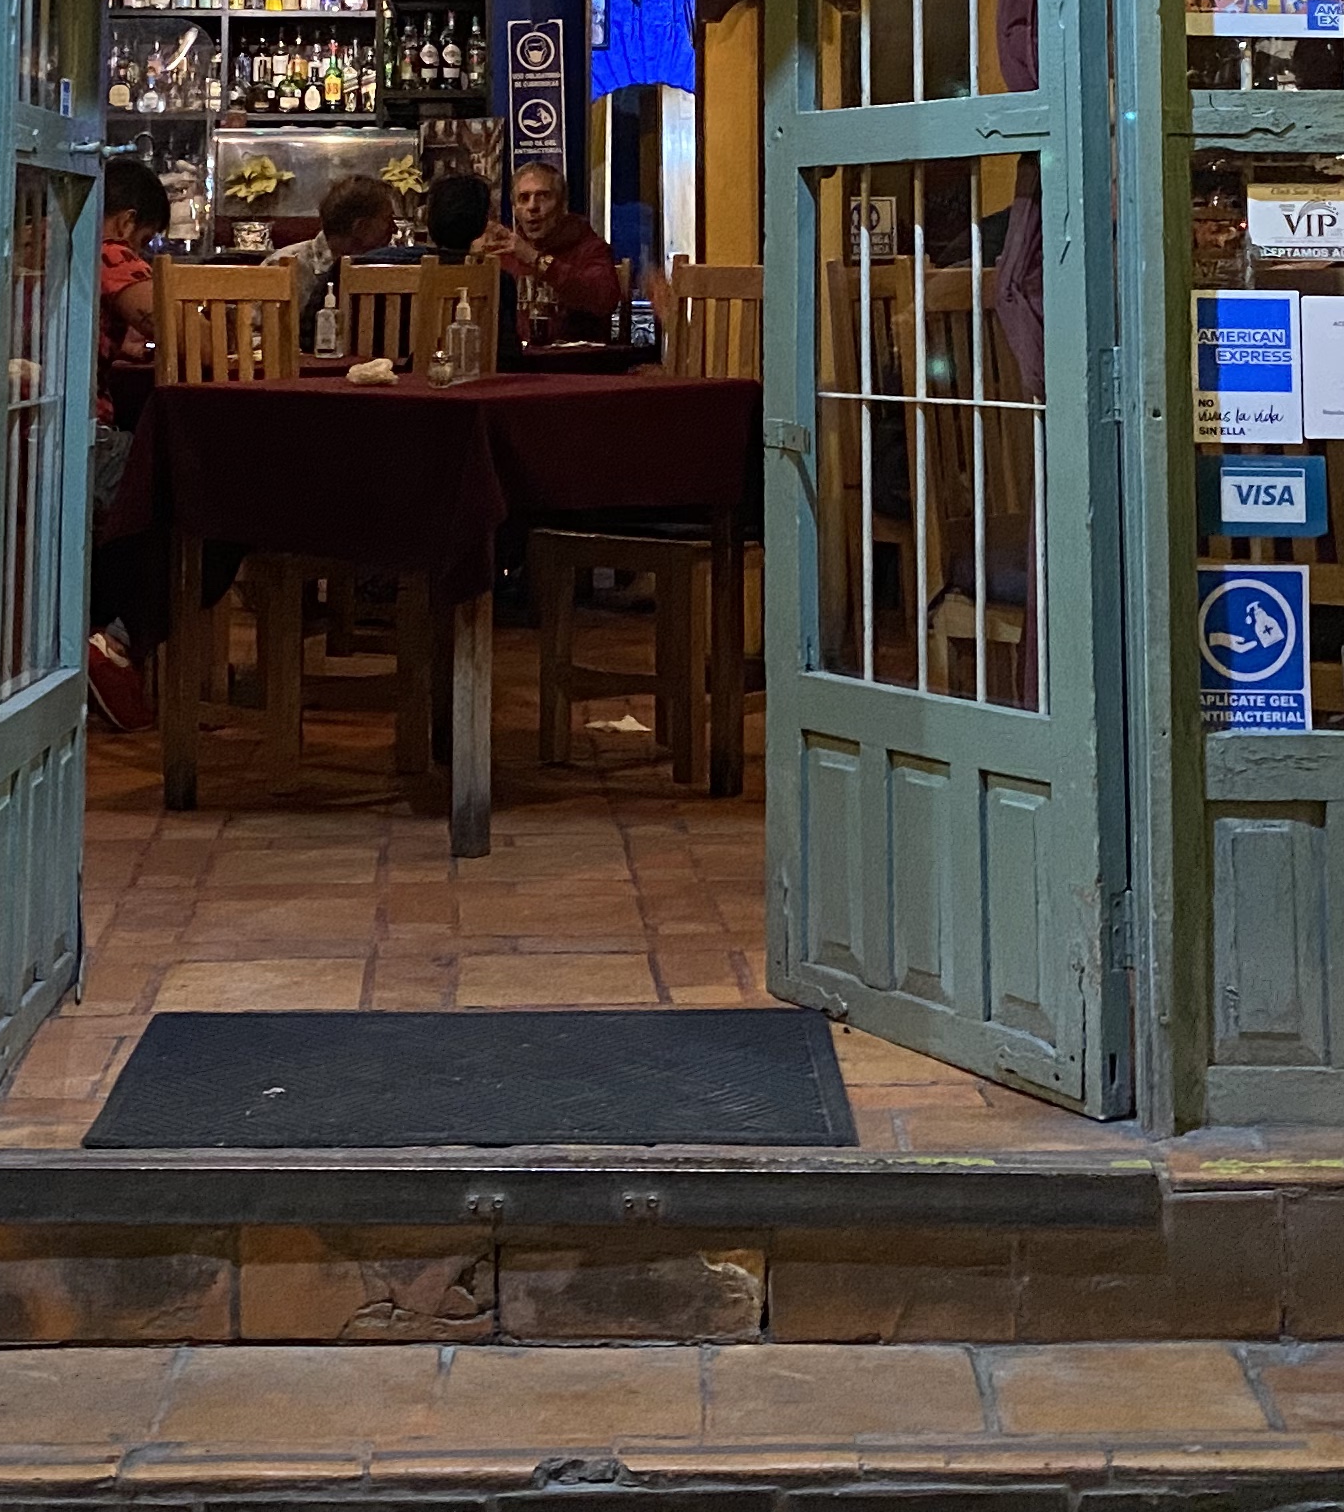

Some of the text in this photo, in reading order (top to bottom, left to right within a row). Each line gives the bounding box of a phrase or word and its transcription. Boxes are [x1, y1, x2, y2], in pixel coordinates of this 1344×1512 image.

[1283, 214, 1337, 236] VIP
[1198, 331, 1283, 344] AMERICAN
[1218, 350, 1293, 363] EXPRESS
[1198, 399, 1214, 408] NO
[1235, 408, 1251, 424] la
[1255, 405, 1284, 424] vida
[1199, 427, 1246, 436] SIN ELLA
[1232, 484, 1295, 505] VISA
[1269, 696, 1298, 706] GEL
[1201, 711, 1304, 722] NTIBACTERIAL
